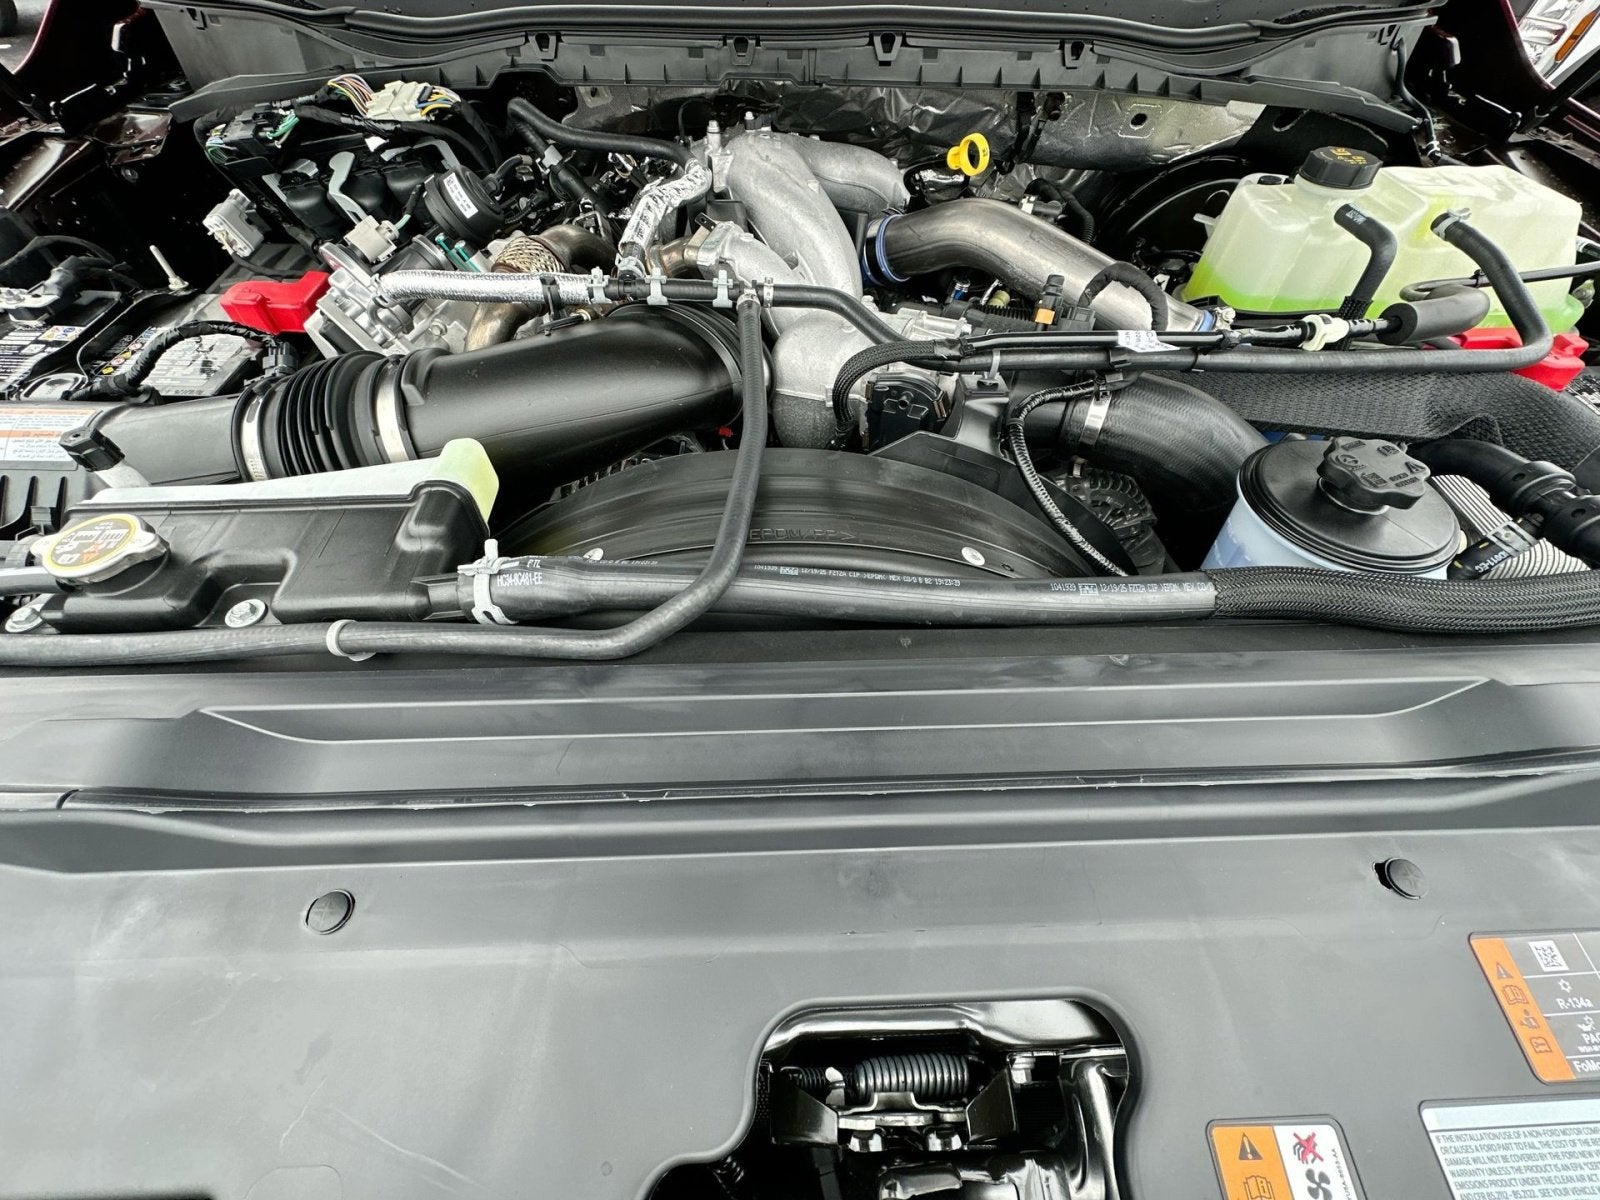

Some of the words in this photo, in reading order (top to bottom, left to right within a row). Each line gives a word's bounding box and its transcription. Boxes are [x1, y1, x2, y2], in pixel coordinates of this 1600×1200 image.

[1556, 996, 1594, 1010] R-134a
[1441, 1134, 1455, 1143] THE
[1527, 1128, 1560, 1138] NON-FORD
[1560, 1128, 1583, 1137] MOTOR
[1449, 1144, 1475, 1154] CAUSES
[1480, 1143, 1497, 1153] FORD
[1497, 1143, 1514, 1152] PART
[1514, 1142, 1524, 1151] TO
[1538, 1140, 1553, 1150] THE
[1552, 1139, 1569, 1149] COST
[1569, 1139, 1577, 1148] OF
[1577, 1138, 1592, 1147] THE
[1445, 1157, 1472, 1166] DAMAGE
[1471, 1156, 1488, 1165] WILL
[1487, 1155, 1501, 1164] NOT
[1501, 1154, 1510, 1163] BE
[1510, 1152, 1539, 1163] COVERED
[1539, 1152, 1548, 1161] BY
[1548, 1151, 1562, 1161] THE
[1561, 1150, 1580, 1160] FORD
[1578, 1150, 1595, 1159] NEW
[1449, 1168, 1486, 1178] WARRANTY
[1486, 1166, 1511, 1176] UNLESS
[1511, 1165, 1525, 1175] THE
[1524, 1164, 1553, 1174] PRODUCT
[1561, 1163, 1571, 1172] AN
[1570, 1162, 1585, 1172] EPA
[1454, 1180, 1489, 1190] EMISSIONS
[1488, 1178, 1518, 1189] PRODUCT
[1518, 1177, 1541, 1186] UNDER
[1540, 1176, 1555, 1185] THE
[1554, 1175, 1575, 1184] CLEAN
[1575, 1174, 1587, 1183] AIR
[1538, 1188, 1552, 1198] SEE
[1551, 1187, 1570, 1197] YOUR
[1570, 1186, 1597, 1196] VEHICLE
